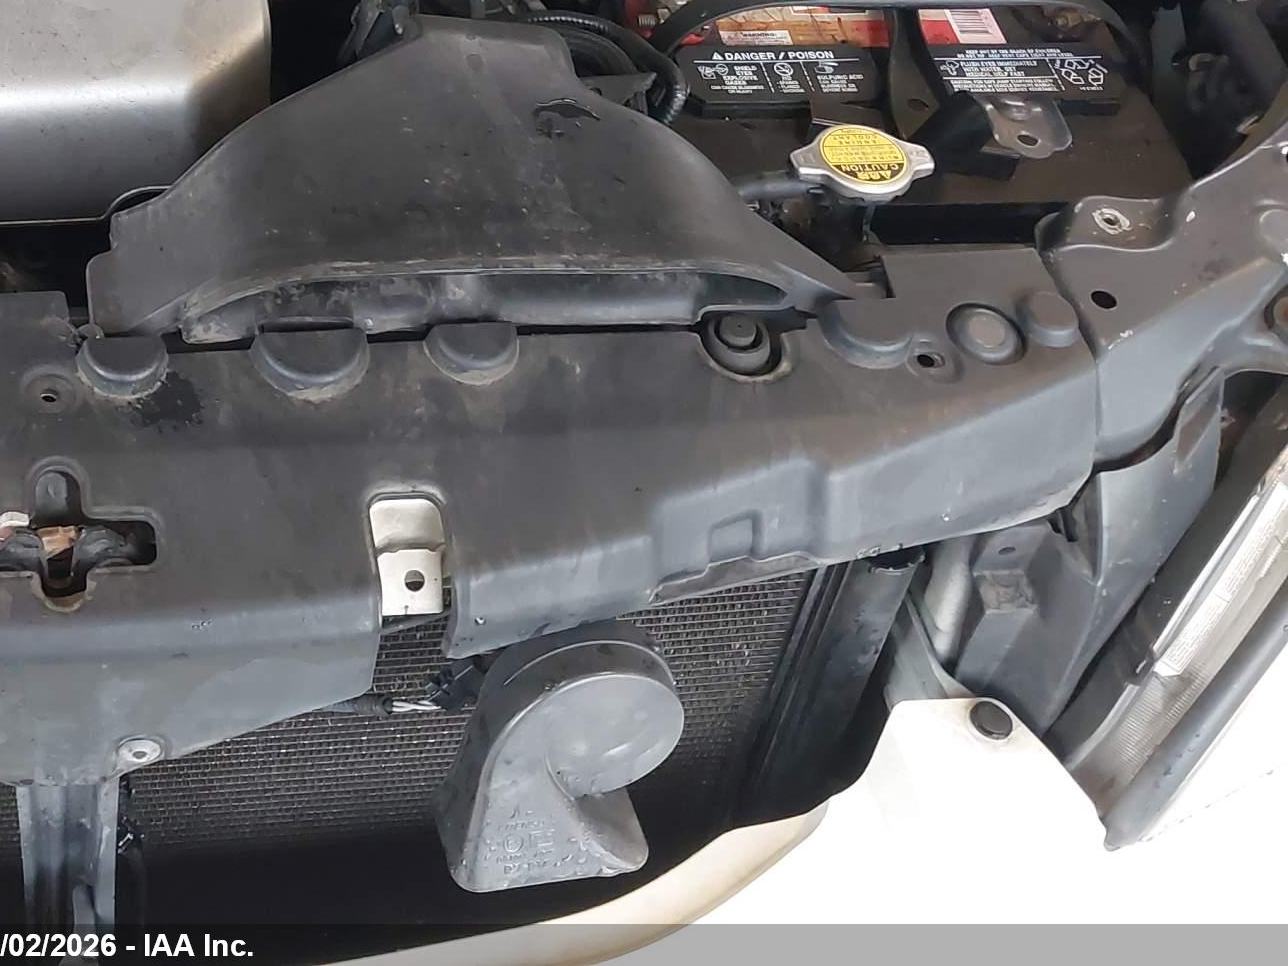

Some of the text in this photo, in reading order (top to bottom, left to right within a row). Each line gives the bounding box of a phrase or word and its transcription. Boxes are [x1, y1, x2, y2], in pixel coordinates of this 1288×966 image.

[724, 50, 835, 60] DANGER / POISON
[840, 163, 899, 172] CAUTION
